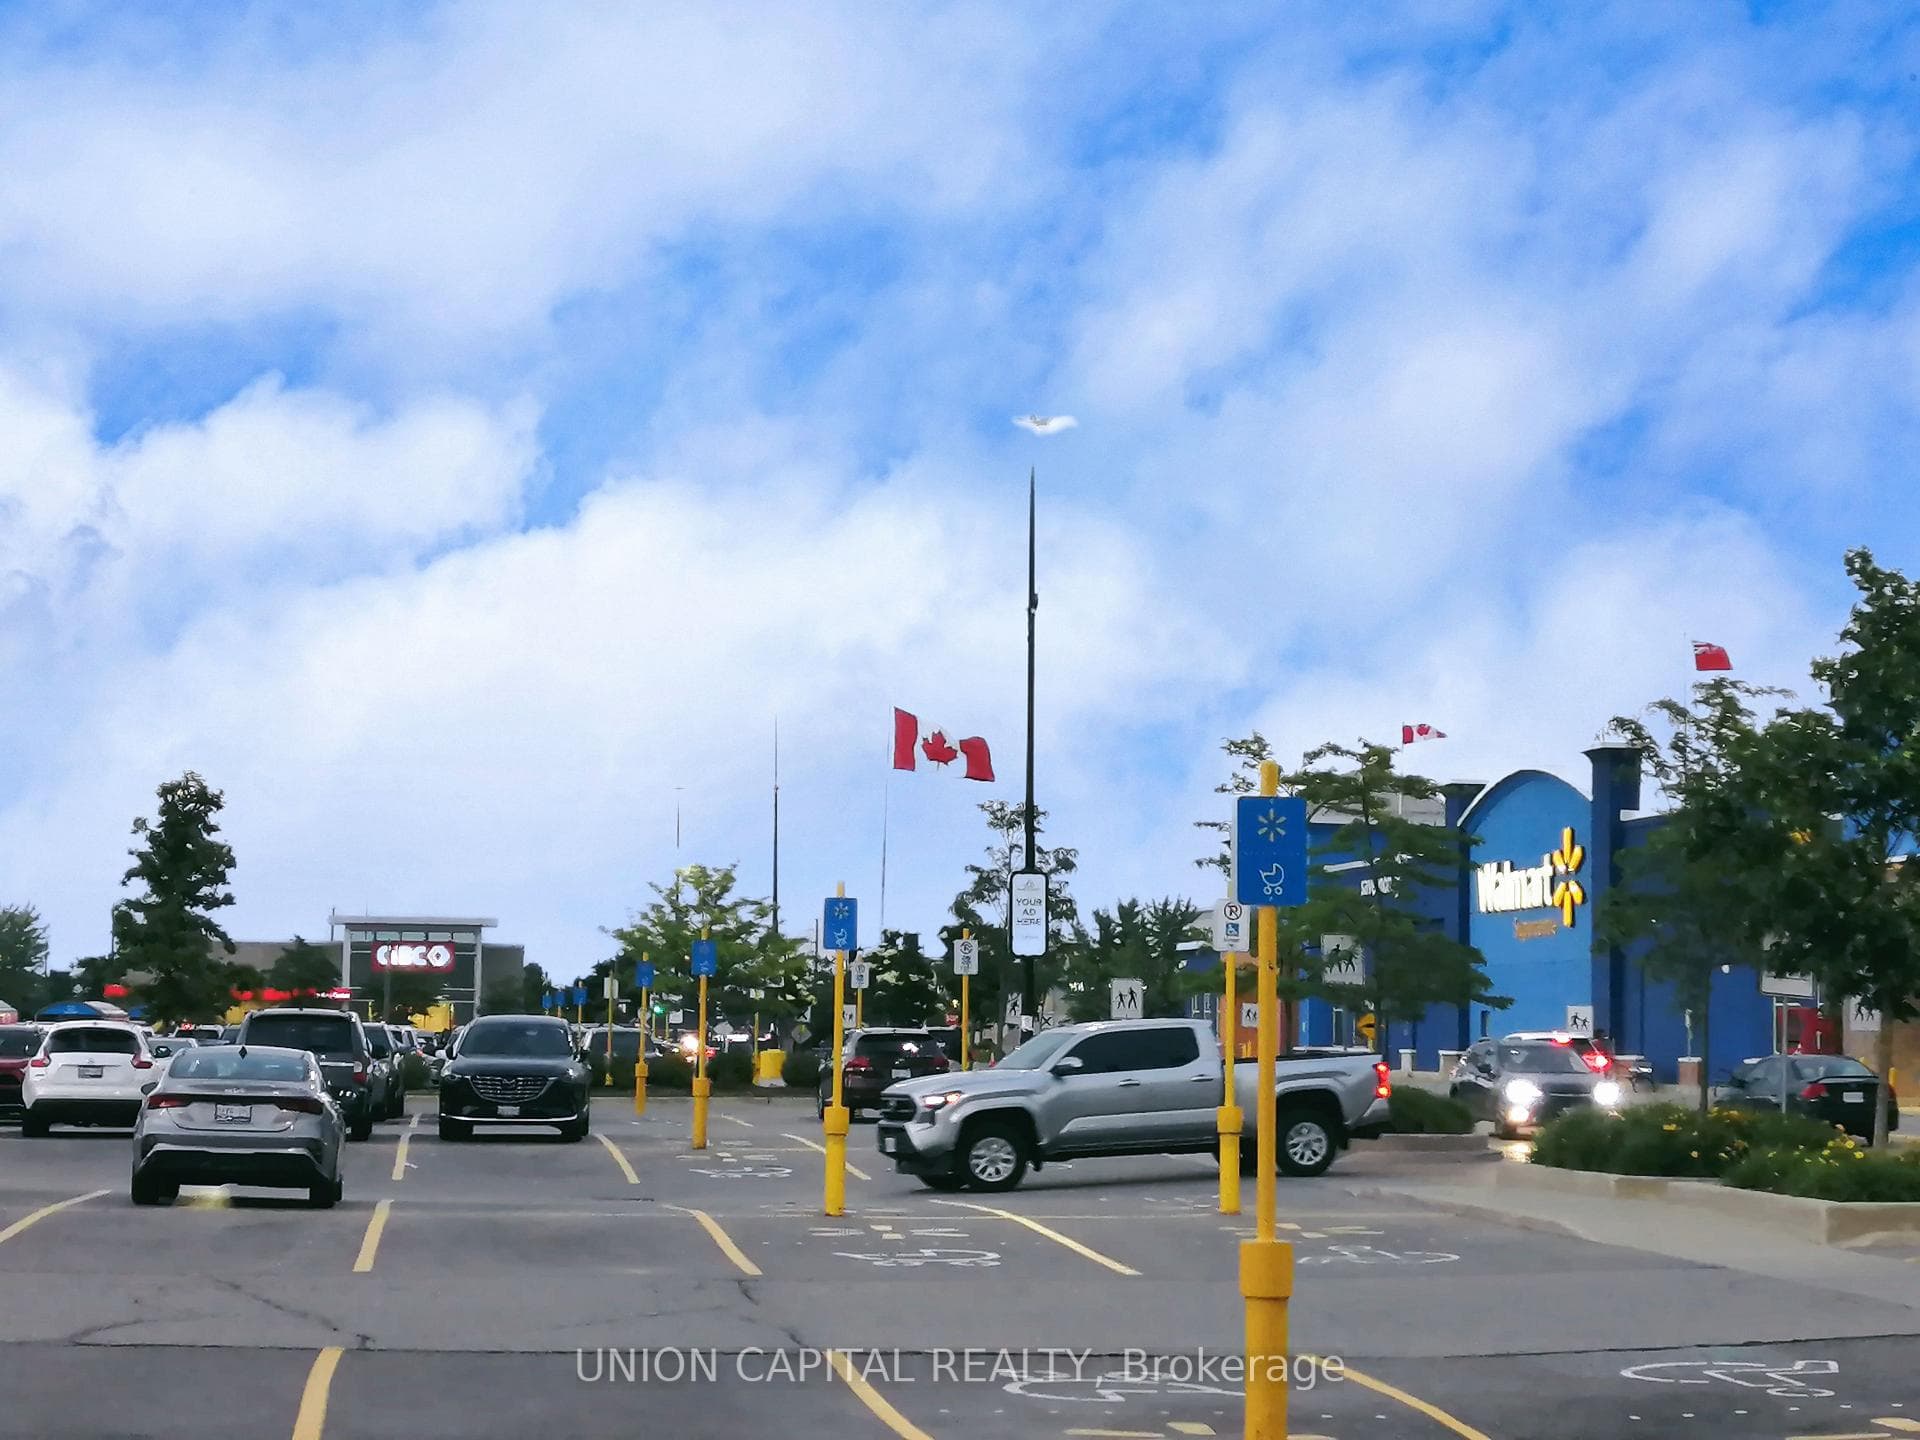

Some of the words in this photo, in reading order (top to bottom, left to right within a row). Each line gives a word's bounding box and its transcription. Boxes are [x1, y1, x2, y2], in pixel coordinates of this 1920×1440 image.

[1478, 853, 1553, 913] Walmart
[1016, 898, 1042, 906] YOUR
[1022, 908, 1036, 916] AD
